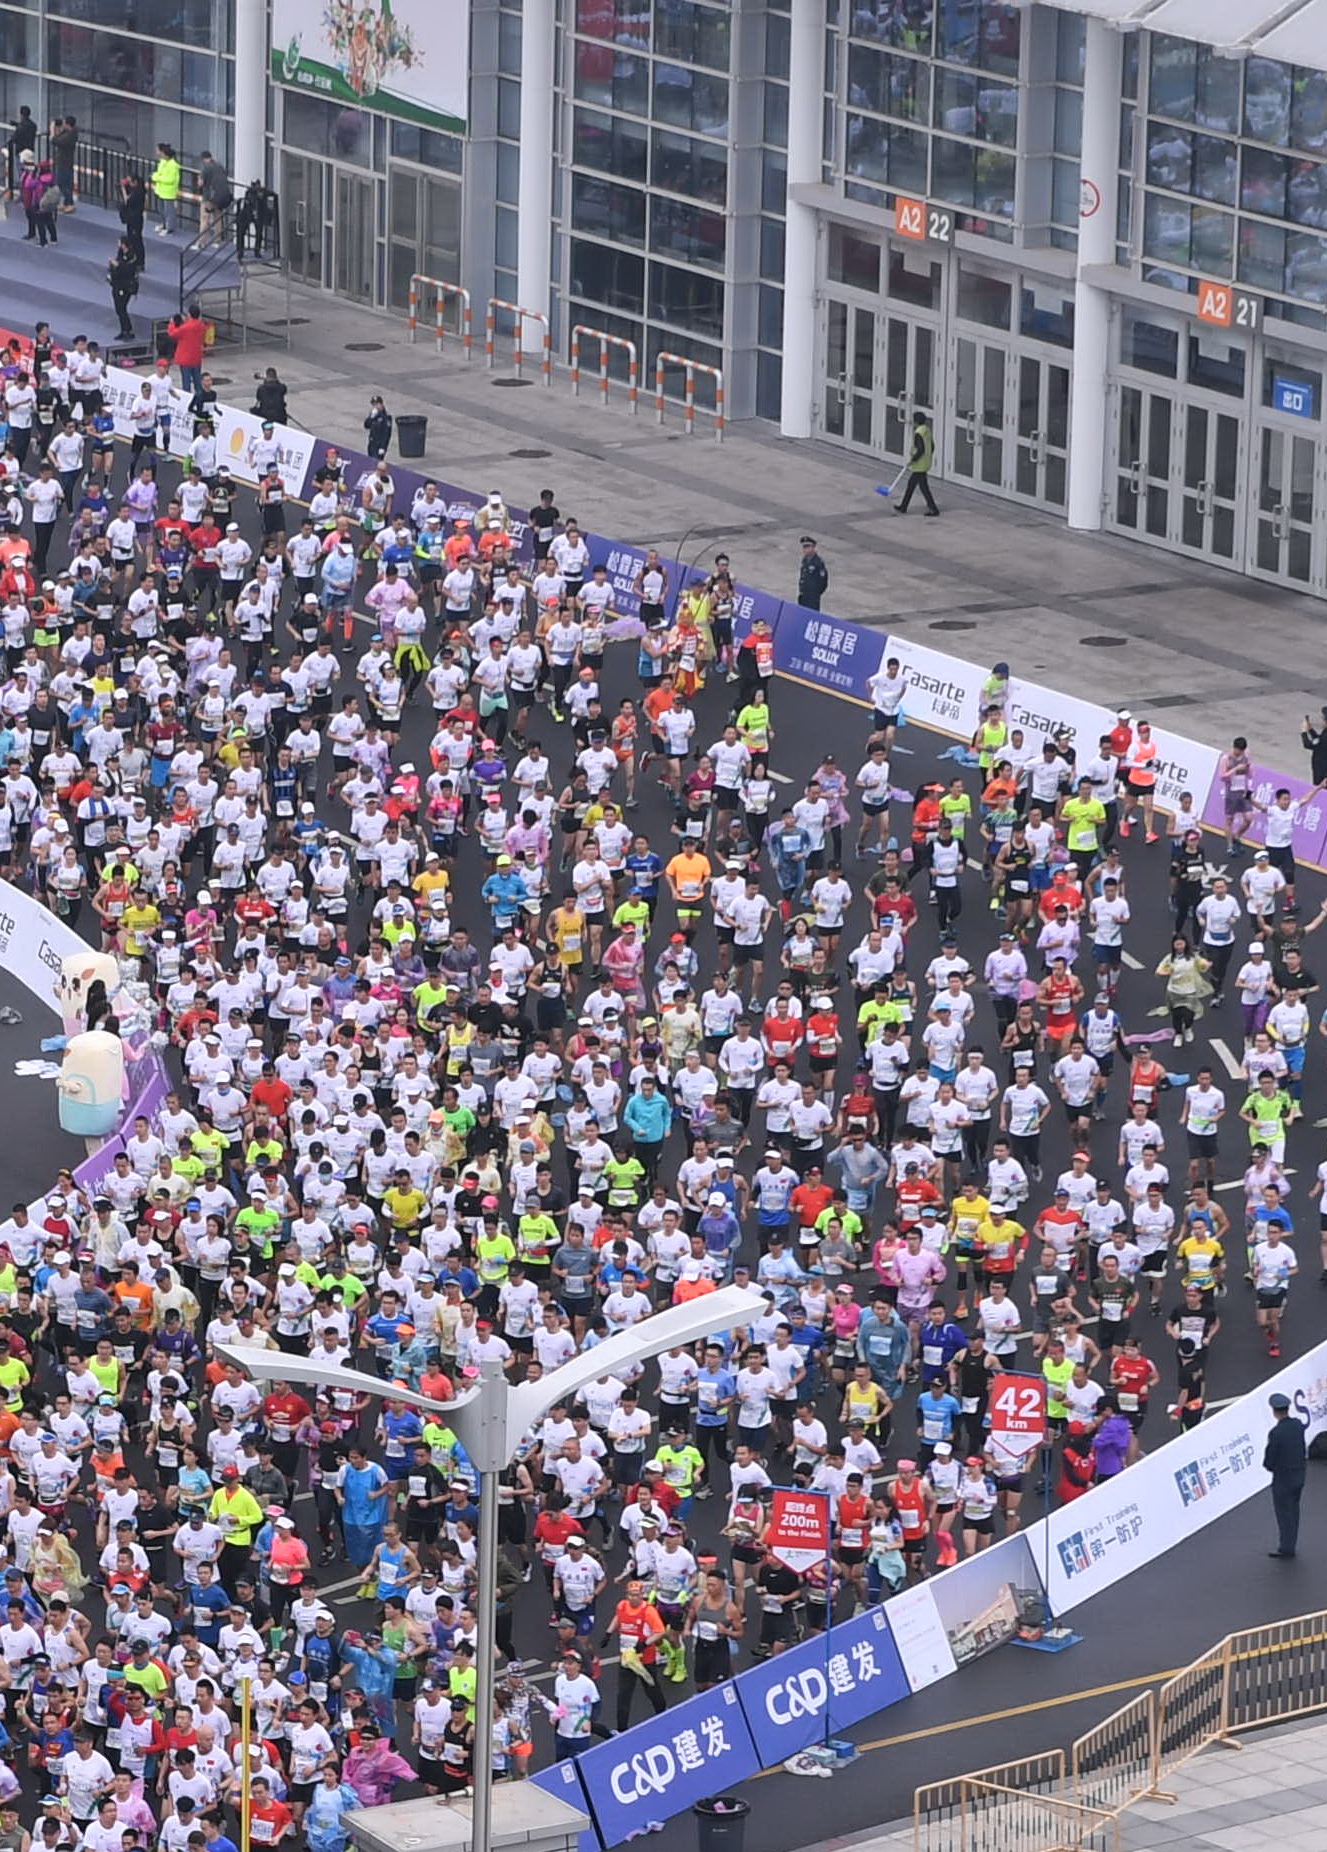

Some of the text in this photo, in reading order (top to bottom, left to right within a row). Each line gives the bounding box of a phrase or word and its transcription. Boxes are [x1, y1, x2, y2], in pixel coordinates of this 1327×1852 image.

[899, 206, 921, 233] A2
[928, 216, 949, 240] 22
[1202, 289, 1227, 319] A2
[1236, 297, 1257, 328] 21
[995, 1387, 1041, 1418] 42
[1006, 1416, 1028, 1429] km
[1220, 1433, 1250, 1457] Training
[1206, 1445, 1254, 1488] 第一防护
[780, 1514, 819, 1528] 200m
[1106, 1502, 1138, 1526] Training
[1090, 1515, 1144, 1560] 第一防护
[764, 1640, 882, 1725] C&D 建发
[610, 1715, 731, 1804] C&D 建发
